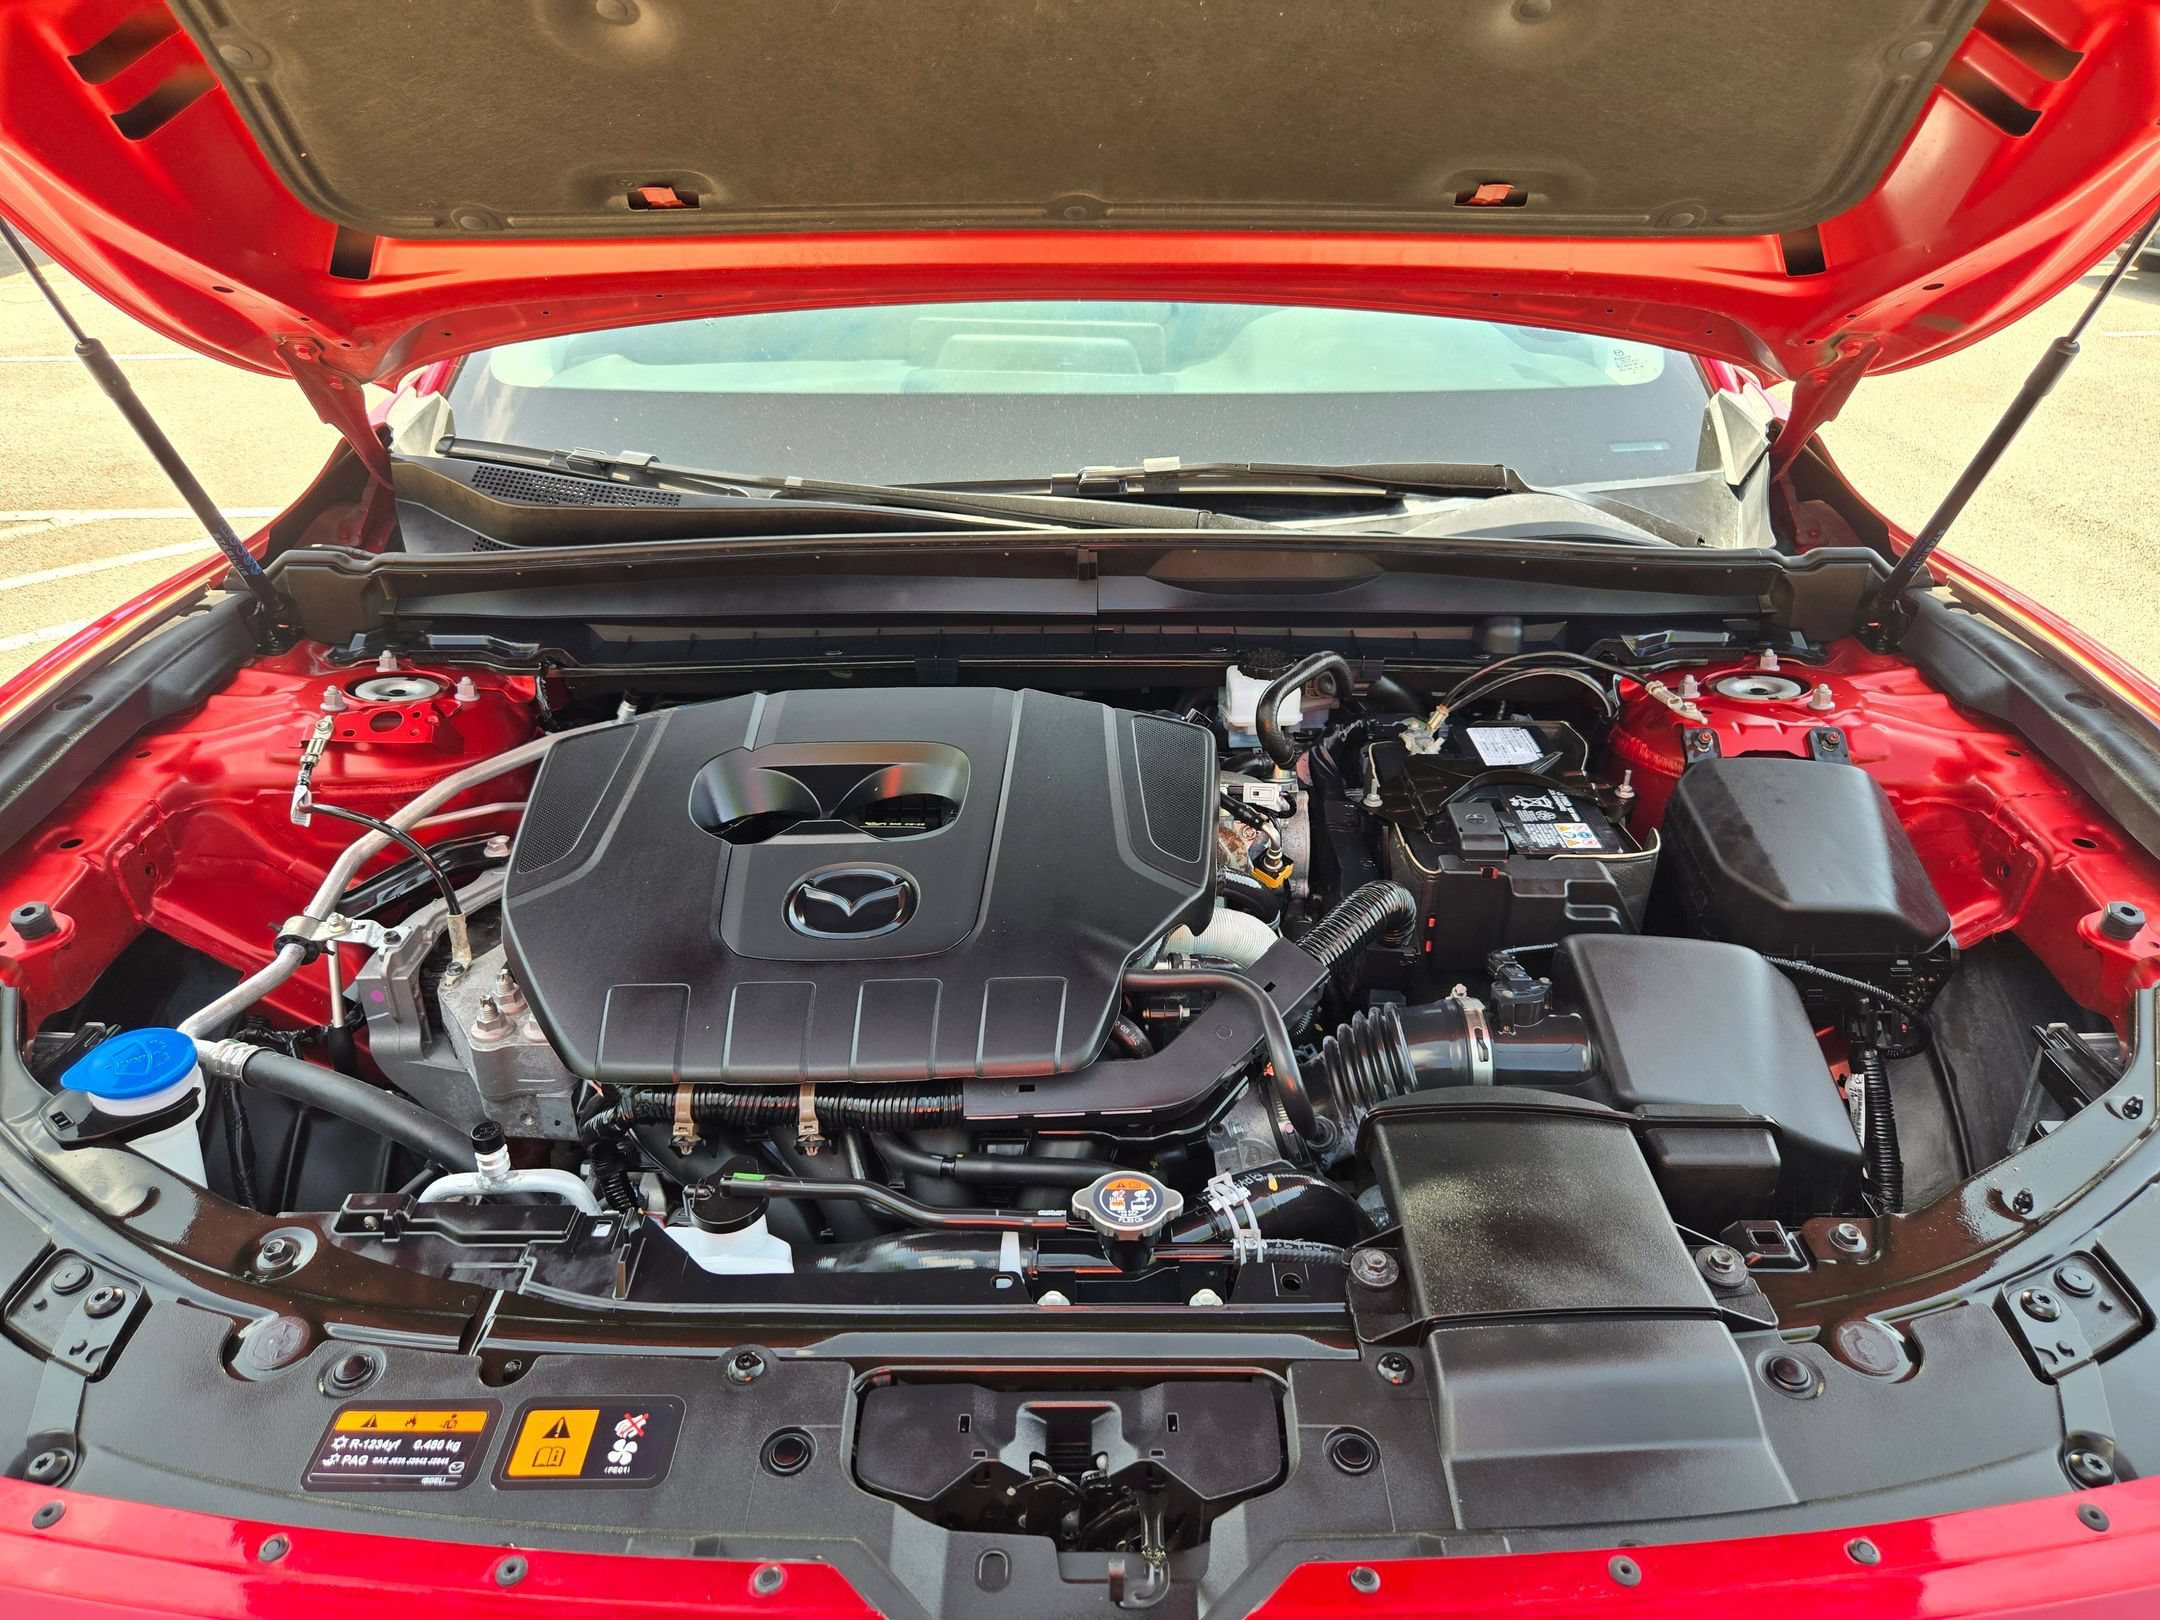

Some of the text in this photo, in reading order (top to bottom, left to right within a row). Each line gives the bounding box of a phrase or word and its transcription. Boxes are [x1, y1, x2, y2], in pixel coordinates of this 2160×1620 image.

[349, 1438, 462, 1453] R-1234yf 0.480 kg
[341, 1454, 369, 1466] PAG
[372, 1456, 389, 1465] SAE
